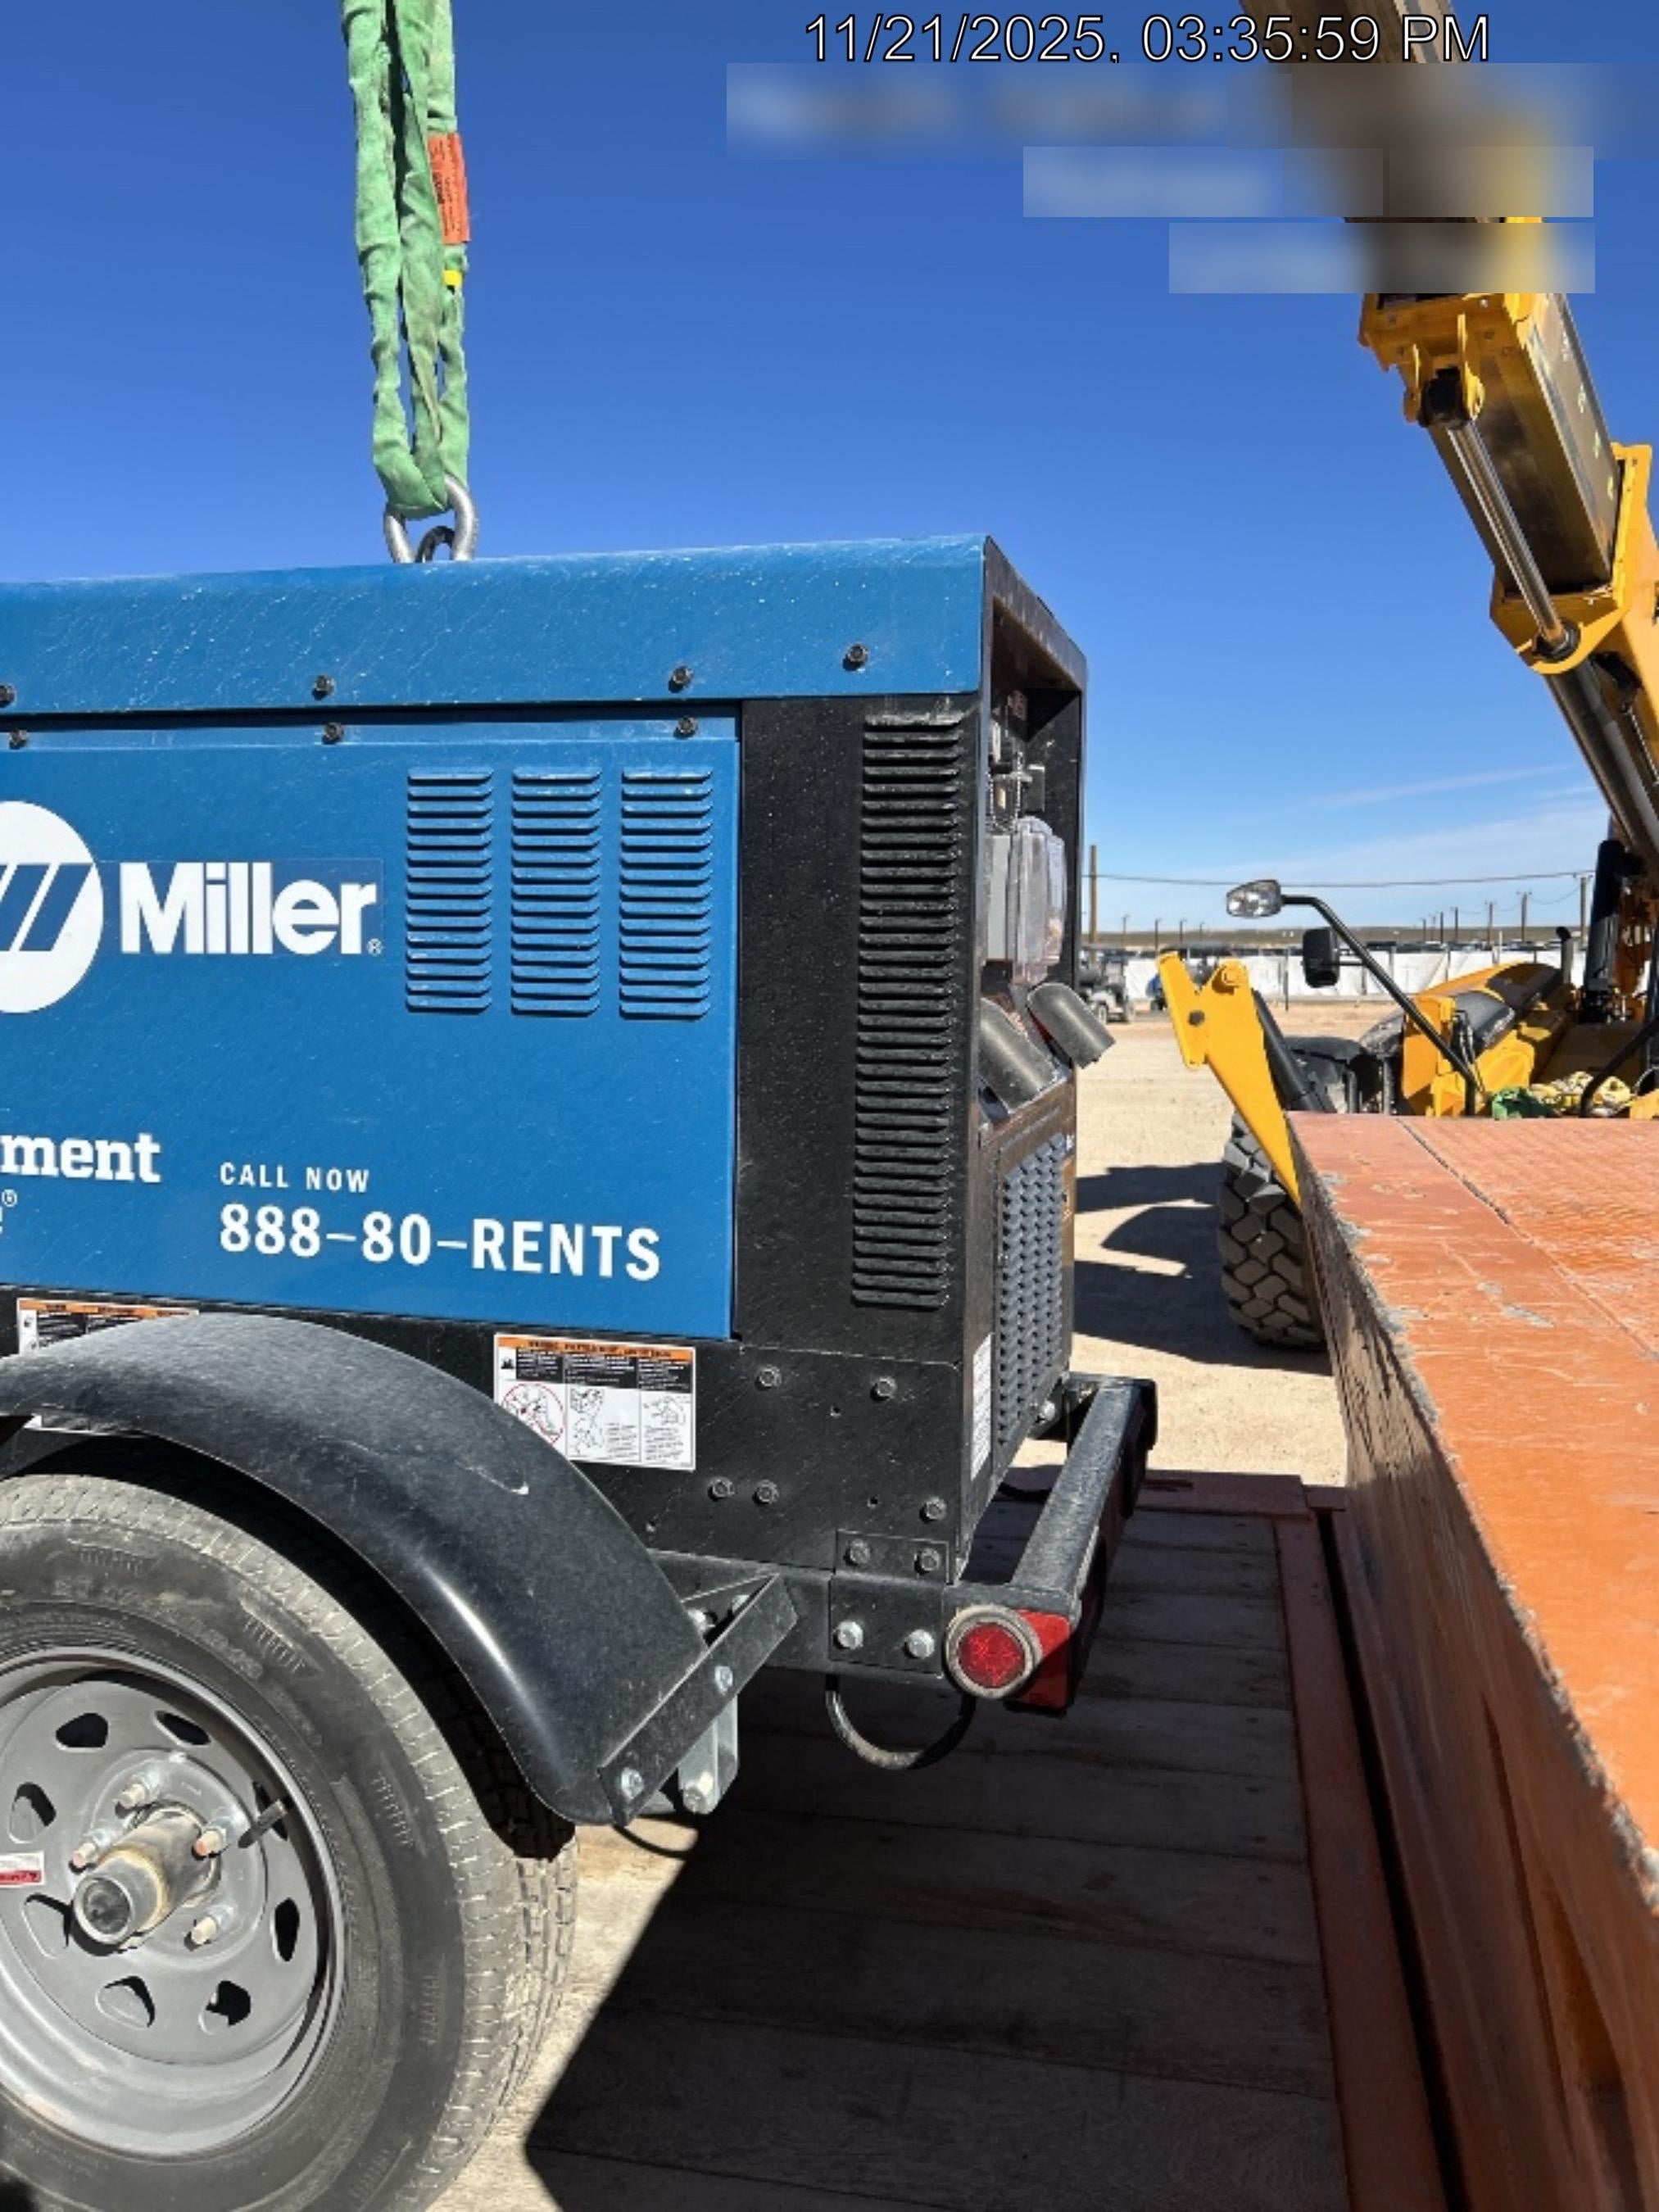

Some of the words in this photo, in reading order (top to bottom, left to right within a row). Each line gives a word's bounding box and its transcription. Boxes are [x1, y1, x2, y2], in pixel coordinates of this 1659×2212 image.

[220, 1162, 289, 1188] CALL
[306, 1167, 369, 1193] NOW
[220, 1203, 660, 1281] 888-80-RENTS
